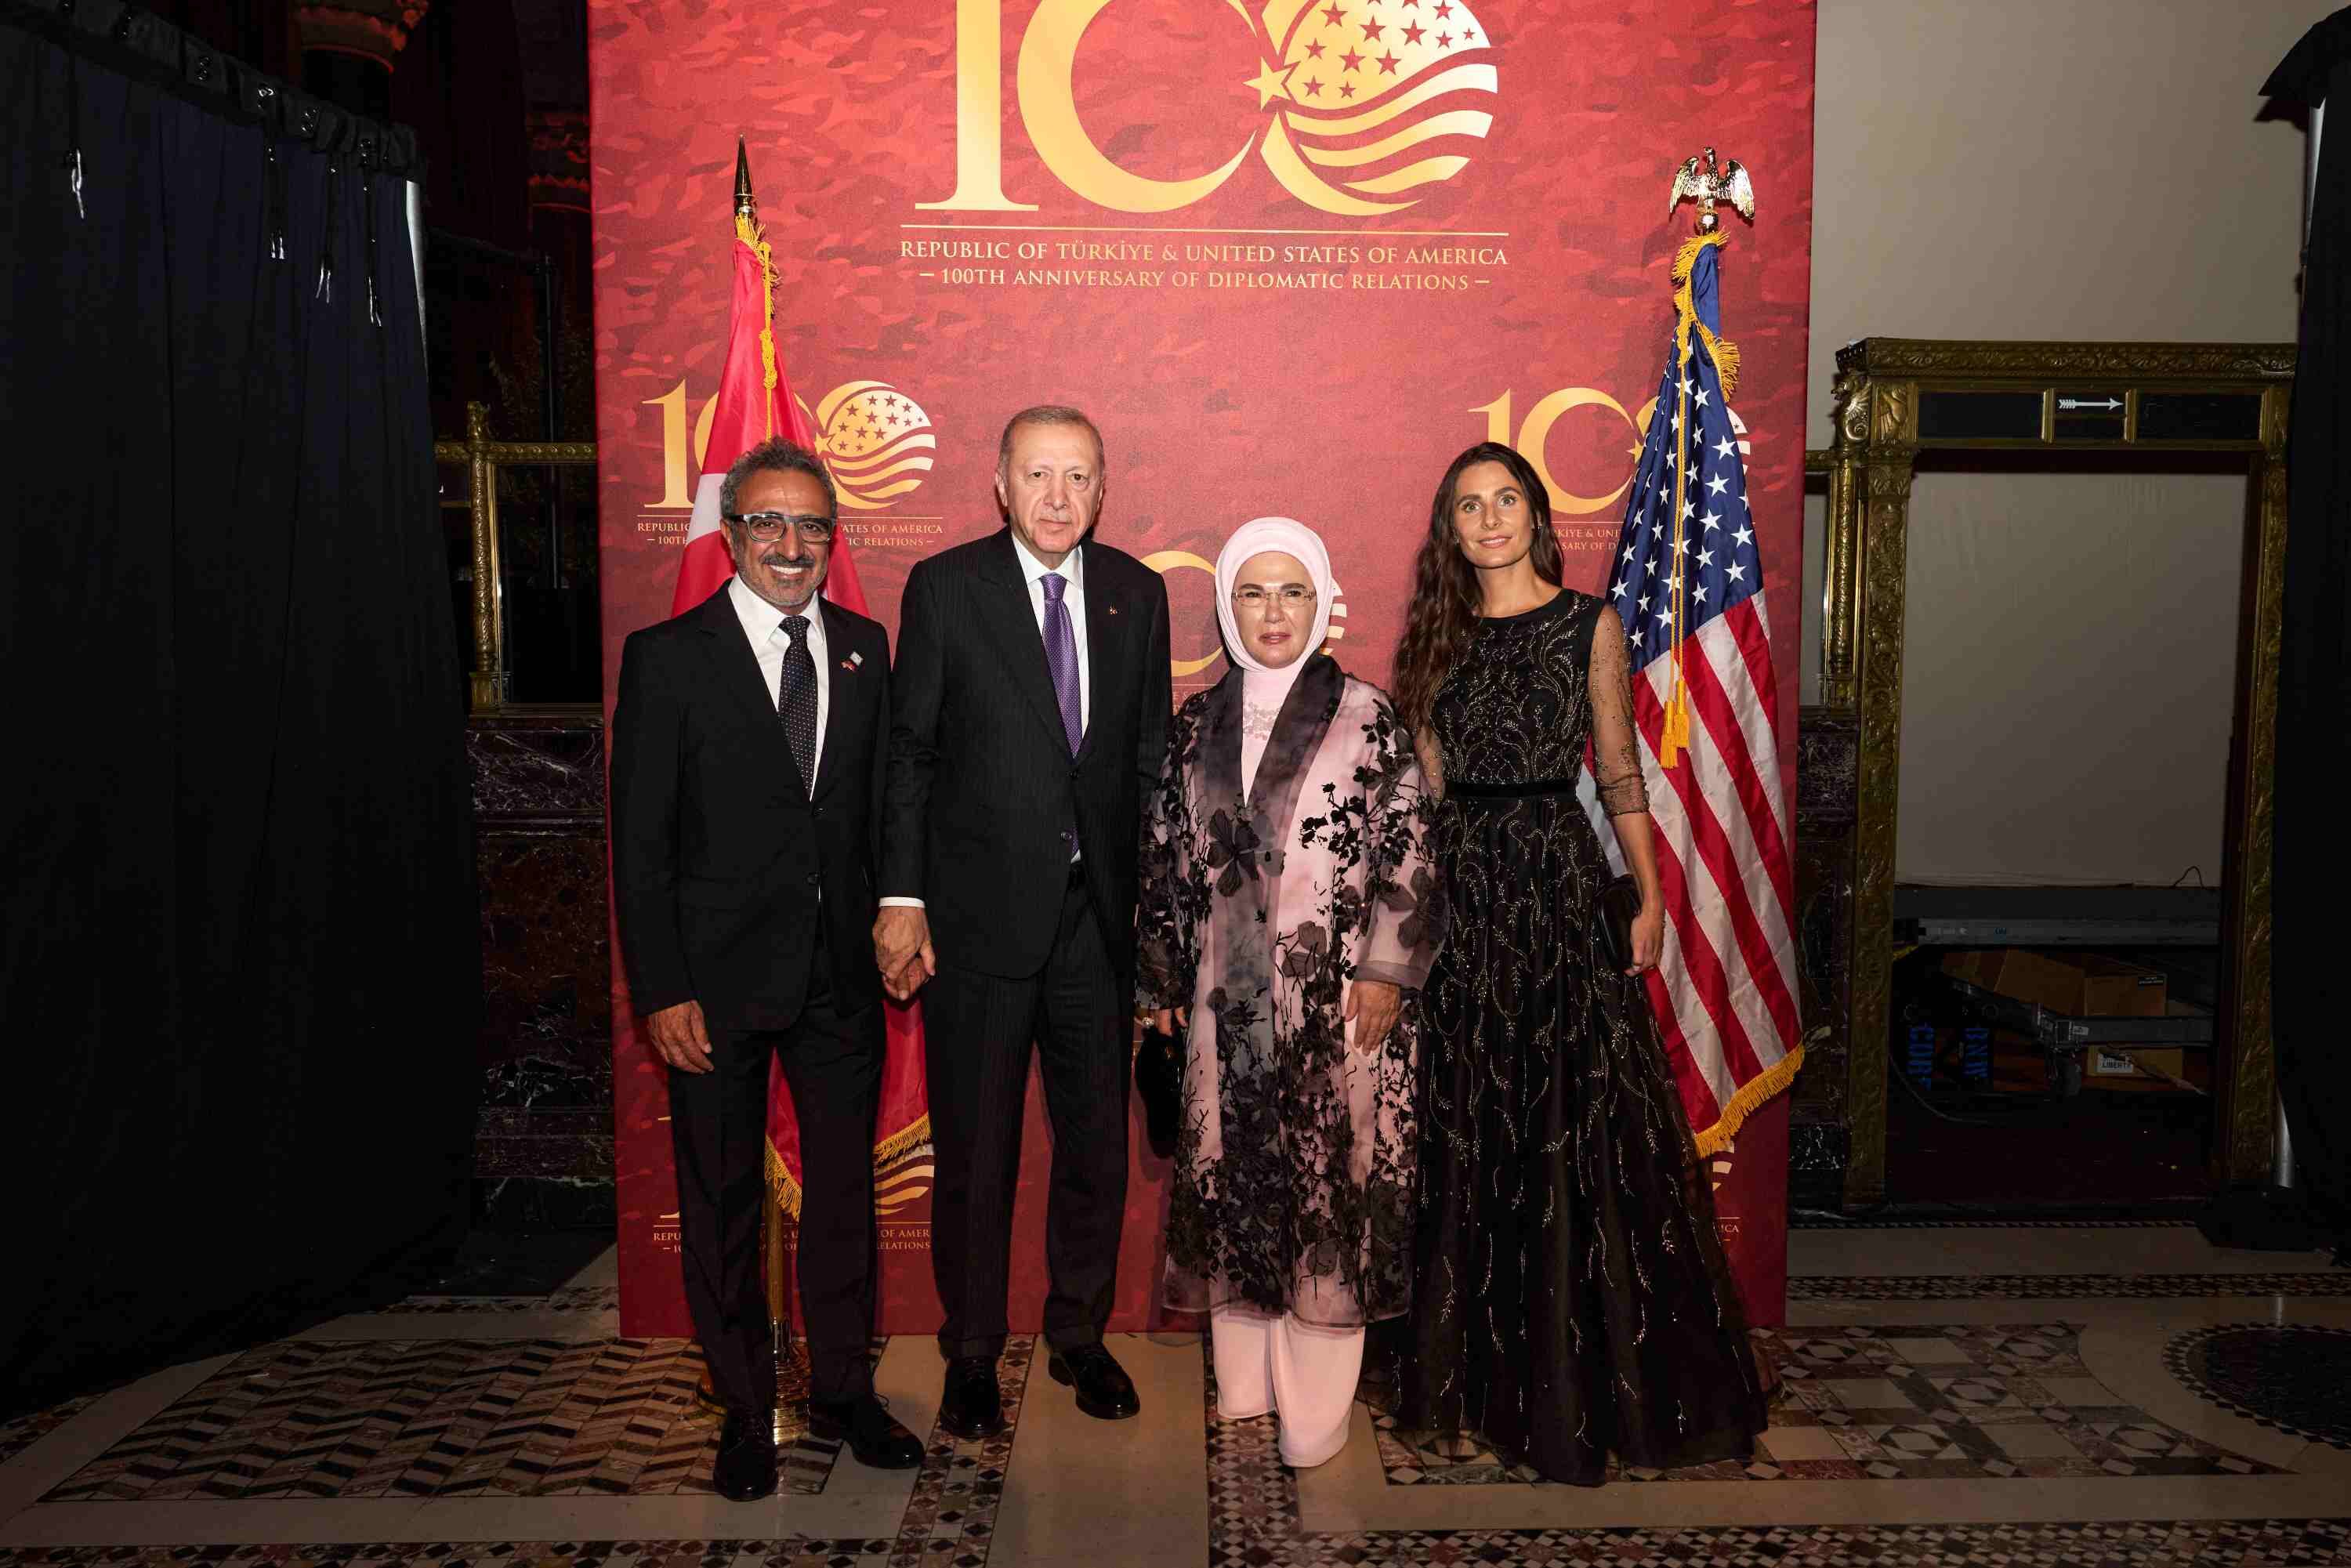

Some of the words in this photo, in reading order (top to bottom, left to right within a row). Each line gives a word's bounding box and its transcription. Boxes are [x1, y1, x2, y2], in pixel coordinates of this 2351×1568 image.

[901, 241, 1010, 259] REPUBLIC
[1019, 243, 1048, 259] OF
[1056, 240, 1154, 261] TÜRKİYE
[1161, 244, 1179, 261] &
[1186, 244, 1275, 263] UNITED
[1284, 246, 1360, 263] STATES
[1368, 247, 1398, 264] OF
[1404, 248, 1509, 265] AMERICA
[941, 268, 1005, 285] 100TH
[1013, 270, 1165, 287] ANNIVERSARY
[1172, 271, 1199, 288] OF
[1208, 272, 1344, 289] DIPLOMATIC
[1353, 273, 1469, 290] RELATIONS
[637, 522, 690, 532] REPUBLIC
[840, 523, 868, 534] ATES
[871, 523, 886, 534] OF
[890, 523, 943, 534] AMERICA
[864, 538, 924, 546] RELATIONS
[653, 1232, 681, 1242] REPU
[880, 1228, 896, 1238] OF
[899, 1228, 930, 1238] AMER
[875, 1240, 931, 1251] ELATIONS
